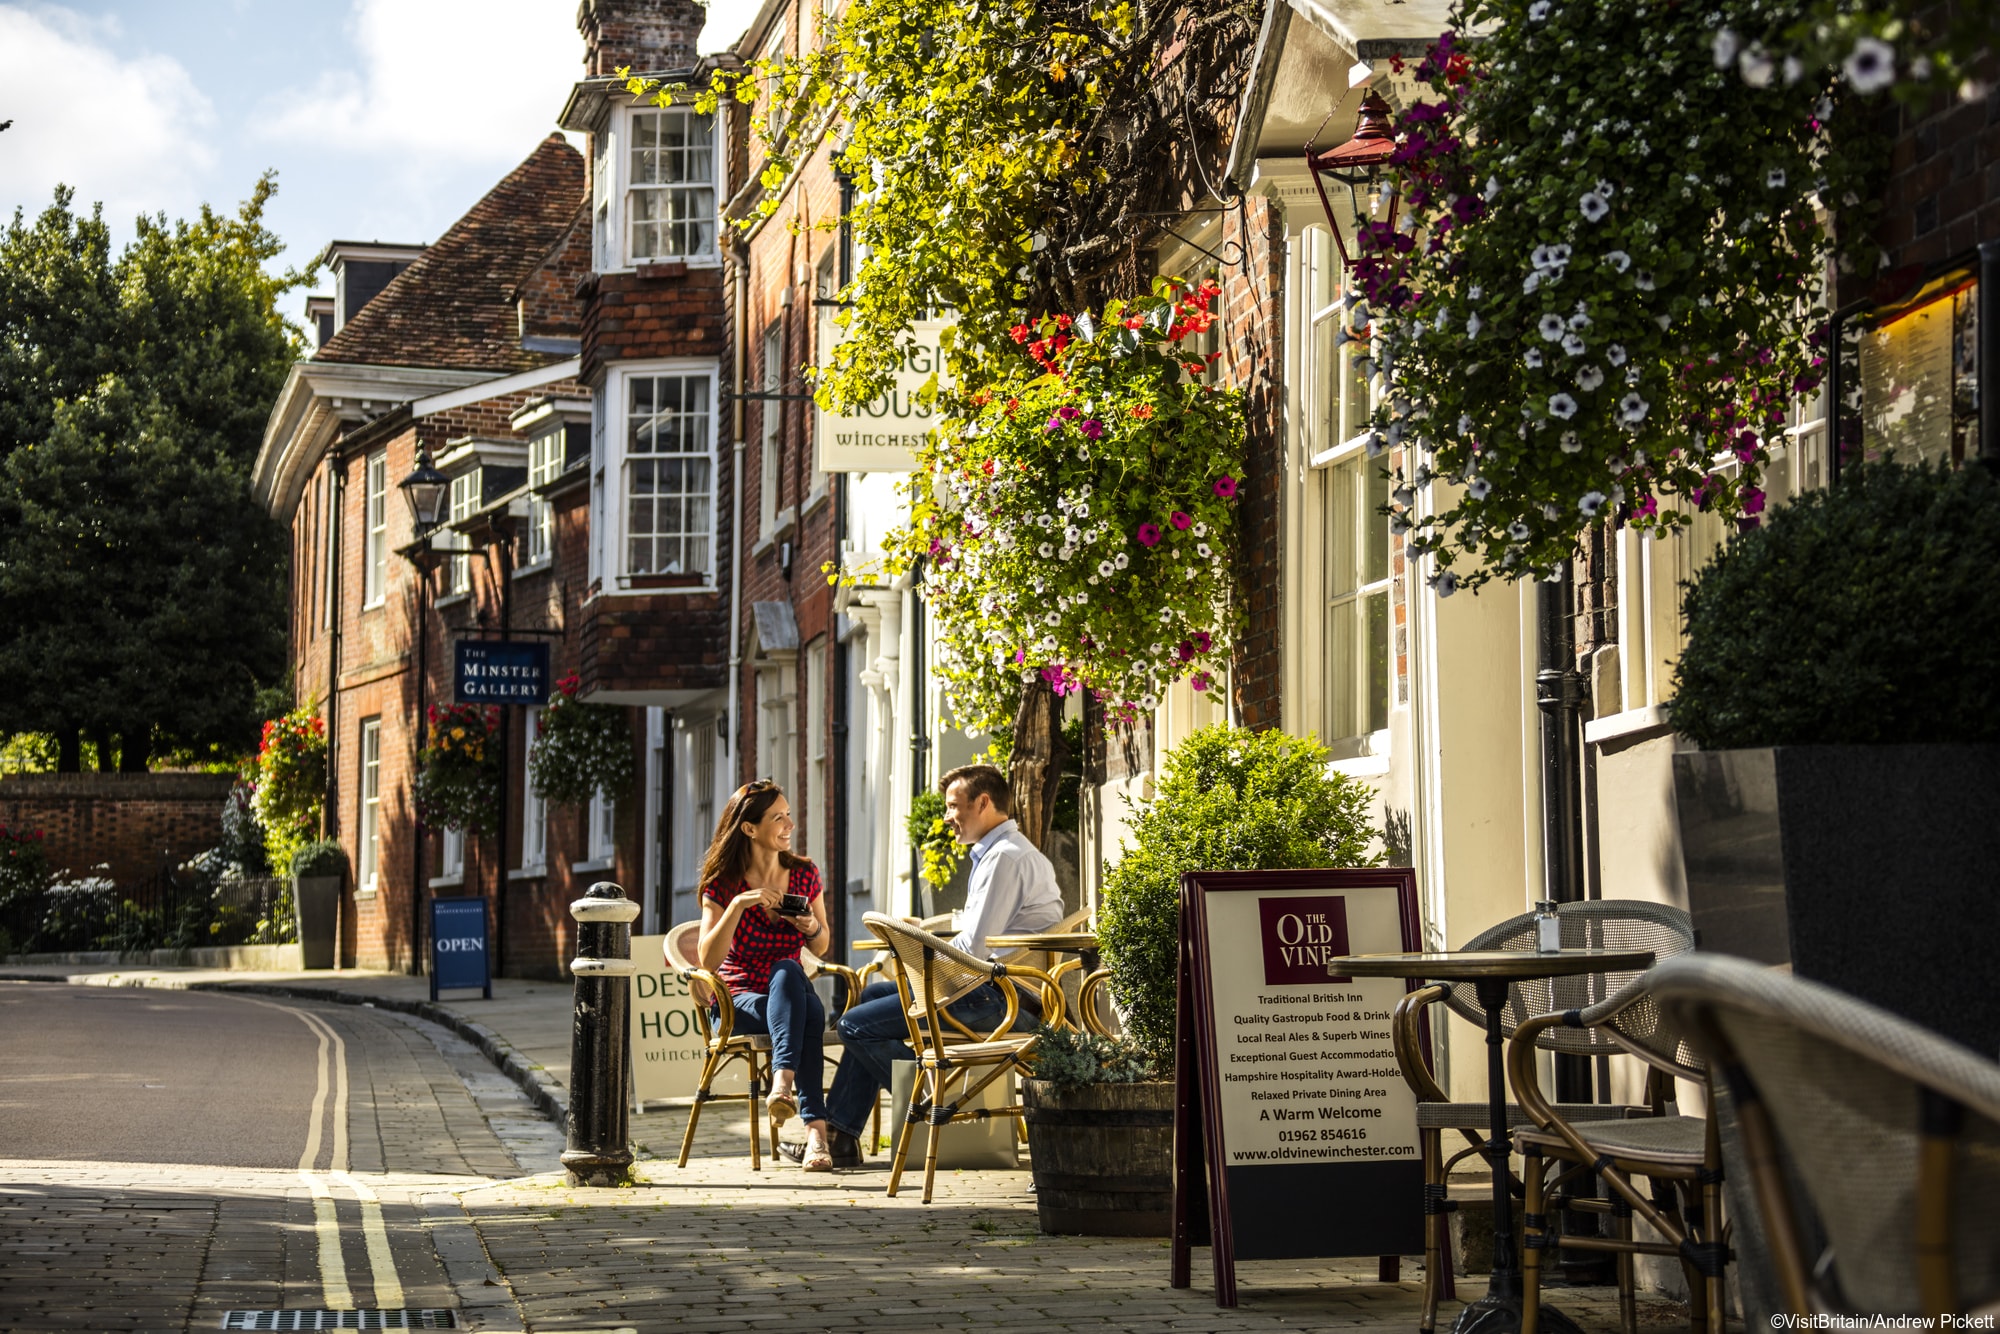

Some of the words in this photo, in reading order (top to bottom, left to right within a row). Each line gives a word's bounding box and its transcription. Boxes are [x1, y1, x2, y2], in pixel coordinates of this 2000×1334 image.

[464, 648, 486, 658] THE
[464, 663, 540, 678] MINSTER
[464, 681, 539, 696] GALLERY
[1306, 914, 1326, 924] THE
[1277, 913, 1333, 945] OLD
[437, 937, 483, 952] OPEN
[636, 973, 690, 998] DES
[1257, 994, 1310, 1004] Traditional
[1313, 993, 1344, 1003] British
[1347, 993, 1363, 1002] Inn
[640, 1009, 711, 1039] HOU
[1234, 1014, 1270, 1025] Quality
[1272, 1013, 1324, 1024] Gastropub
[1326, 1012, 1350, 1021] Food
[1353, 1012, 1361, 1021] &
[1364, 1011, 1390, 1020] Drink
[1237, 1033, 1262, 1043] Local
[1265, 1033, 1286, 1042] Real
[1288, 1032, 1309, 1042] Ales
[1312, 1032, 1320, 1041] &
[1322, 1030, 1357, 1042] Superb
[1360, 1030, 1391, 1040] Wines
[1230, 1051, 1287, 1064] Exceptional
[1289, 1051, 1318, 1061] Guest
[1320, 1049, 1396, 1060] Accommodatio
[1224, 1072, 1278, 1083] Hampshire
[1280, 1069, 1334, 1082] Hospitality
[1251, 1090, 1289, 1100] Relaxed
[1292, 1089, 1327, 1099] Private
[1330, 1088, 1361, 1099] Dining
[1364, 1088, 1387, 1097] Area
[1259, 1109, 1270, 1121] A
[1273, 1108, 1314, 1121] Warm
[1318, 1106, 1382, 1120] Welcome
[1278, 1130, 1317, 1142] 01962
[1320, 1128, 1366, 1141] 854616
[1233, 1145, 1415, 1161] www.oldvinewinchester.com
